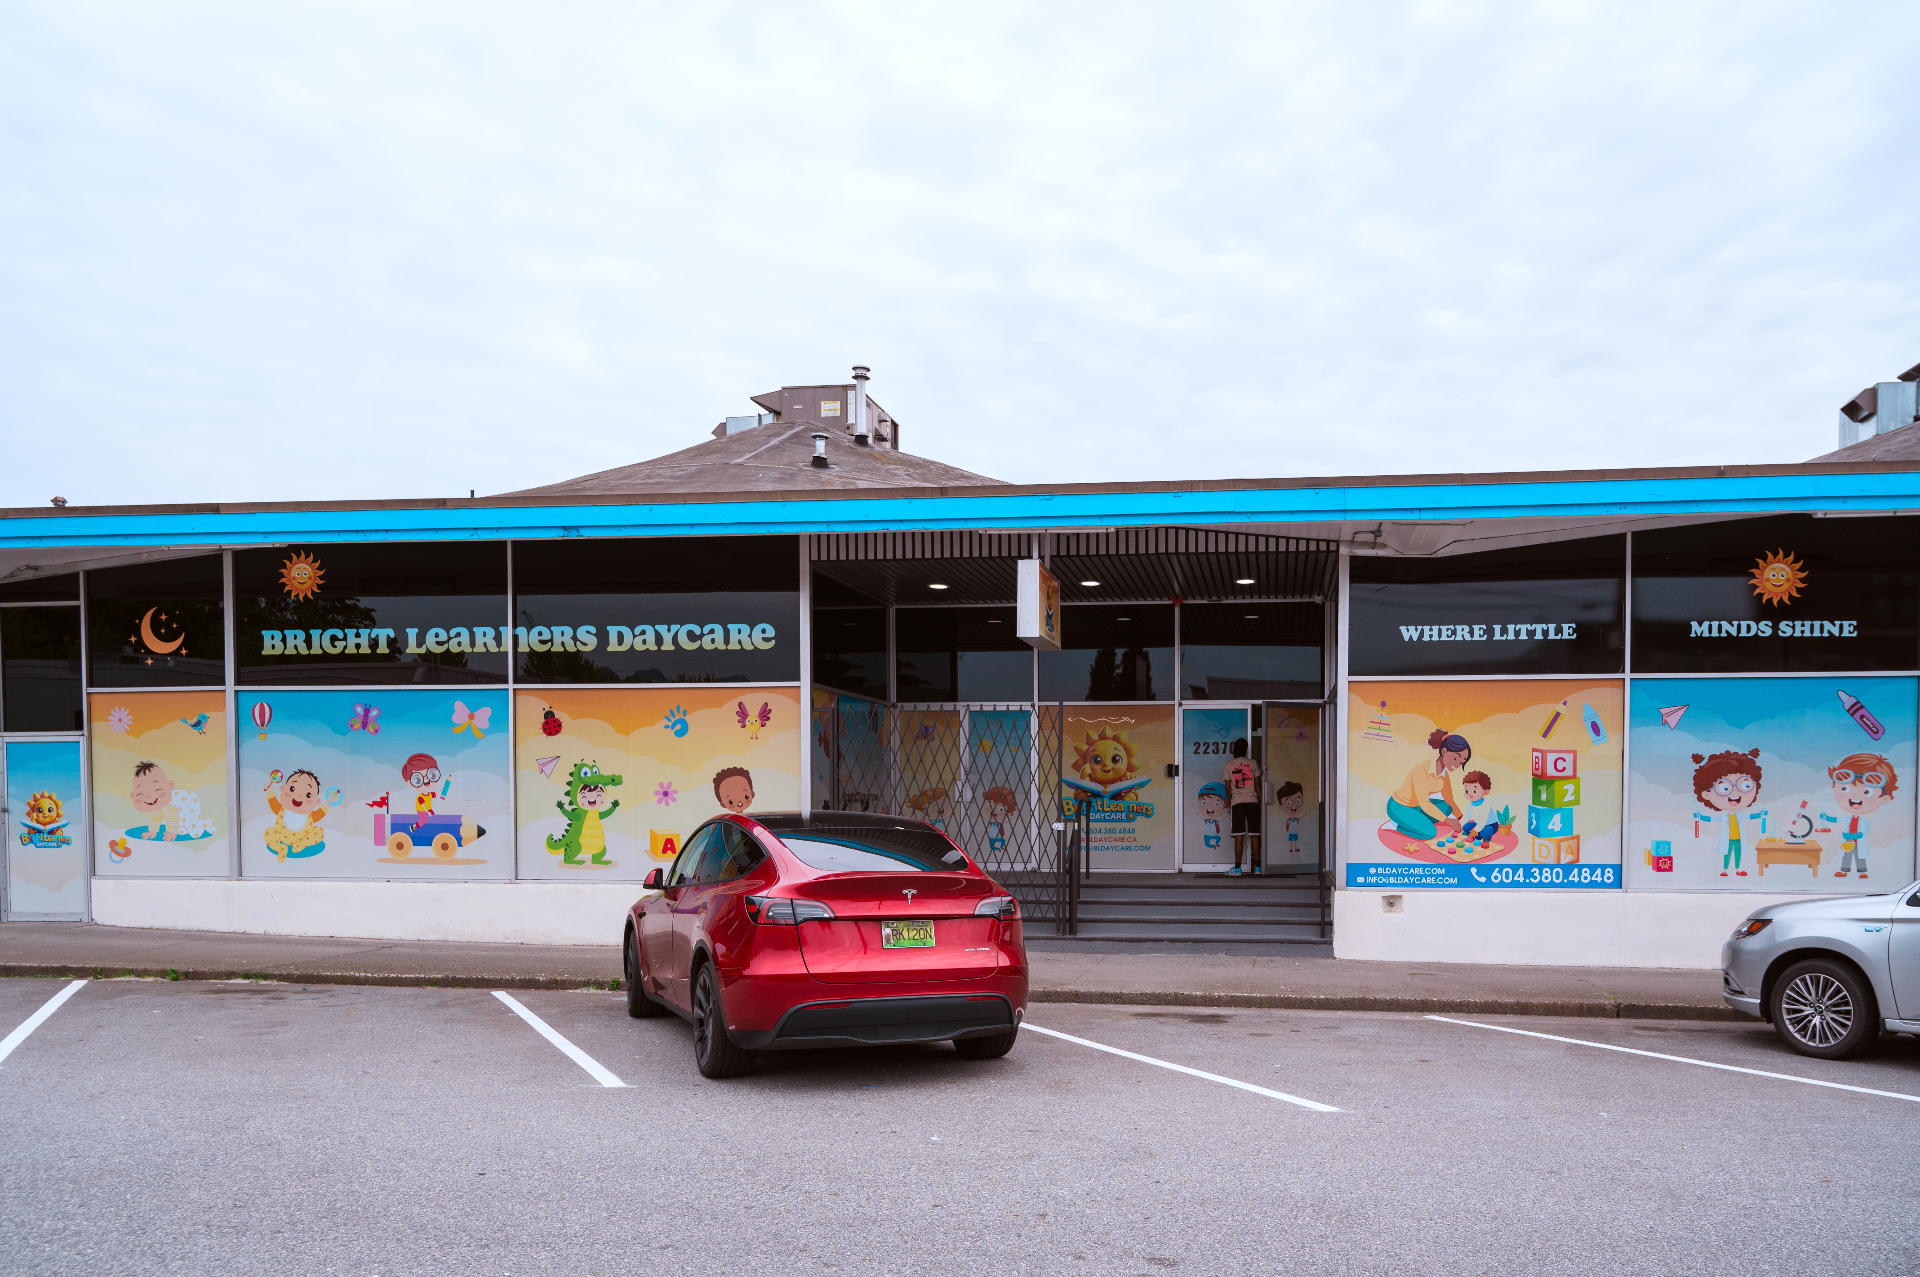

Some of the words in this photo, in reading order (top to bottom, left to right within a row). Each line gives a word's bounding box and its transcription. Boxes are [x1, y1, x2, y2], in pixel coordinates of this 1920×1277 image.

[1399, 624, 1488, 642] WHERE
[1492, 623, 1577, 641] LITTLE
[1690, 620, 1773, 637] MINDS
[1778, 620, 1858, 637] SHINE
[261, 628, 395, 655] BRIGHT
[1534, 755, 1540, 771] B
[1553, 756, 1567, 773] C
[1537, 784, 1547, 801] 1
[1562, 783, 1576, 802] 2
[1089, 812, 1127, 820] DAYCARE
[1530, 812, 1537, 830] 3
[1547, 813, 1562, 832] 4
[1089, 827, 1136, 835] 604.380.4848
[661, 837, 677, 855] A
[1538, 843, 1551, 859] D
[1563, 843, 1575, 860] A
[1366, 876, 1458, 885] INFO@BLDAYCARE.COM
[1377, 867, 1446, 875] BLDAYCARE.COM
[1490, 867, 1615, 884] 604.380.4848
[891, 927, 933, 941] RK120N
